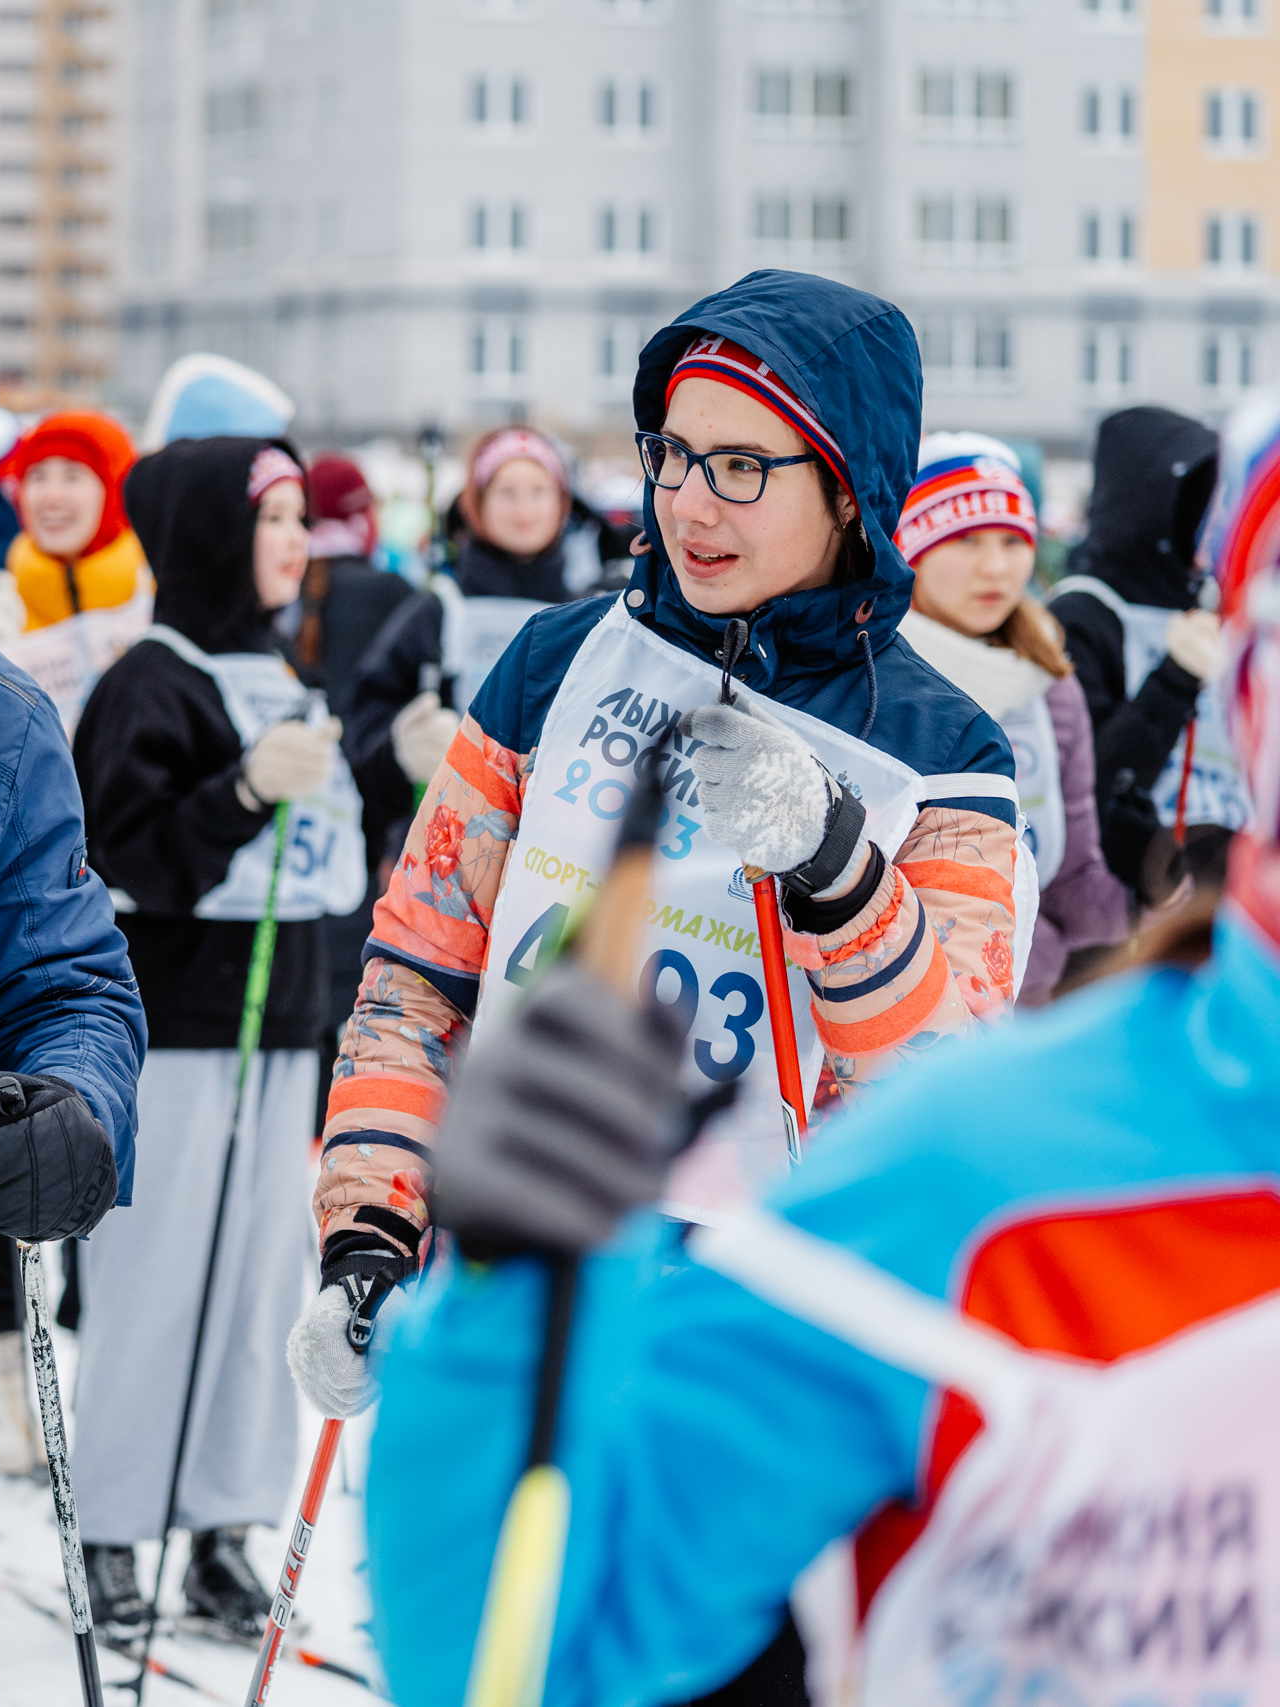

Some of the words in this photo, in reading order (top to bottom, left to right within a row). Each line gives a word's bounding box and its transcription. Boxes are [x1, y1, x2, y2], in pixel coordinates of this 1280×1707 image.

[596, 687, 709, 759] ЛЫЖ
[553, 758, 702, 860] 203
[524, 846, 589, 893] СПОРТ
[641, 899, 703, 939] РМА
[504, 901, 765, 1083] 493
[273, 1518, 313, 1628] STC
